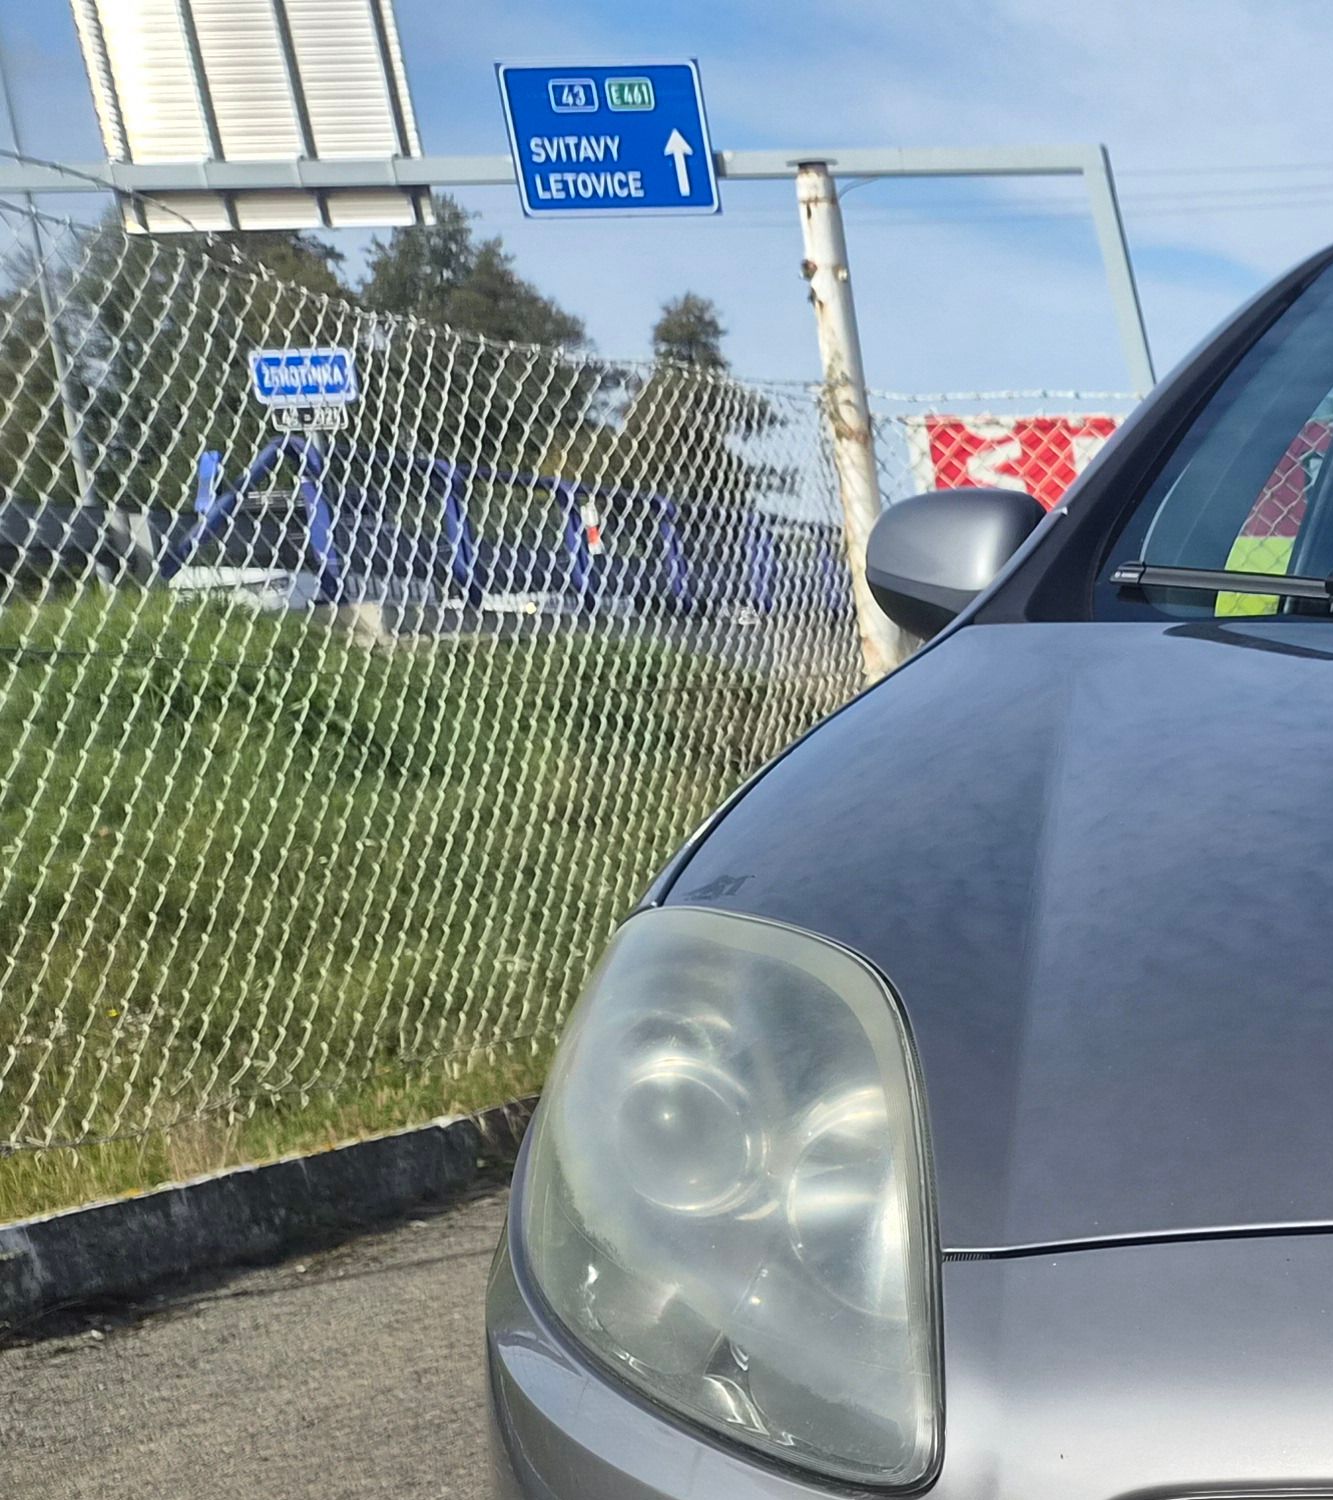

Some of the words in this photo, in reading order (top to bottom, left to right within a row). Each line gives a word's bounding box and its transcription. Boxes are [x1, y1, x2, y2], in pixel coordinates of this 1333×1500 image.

[562, 86, 585, 106] 43
[610, 85, 621, 105] E
[530, 135, 619, 163] SVITAVY
[535, 171, 644, 199] LETOVICE
